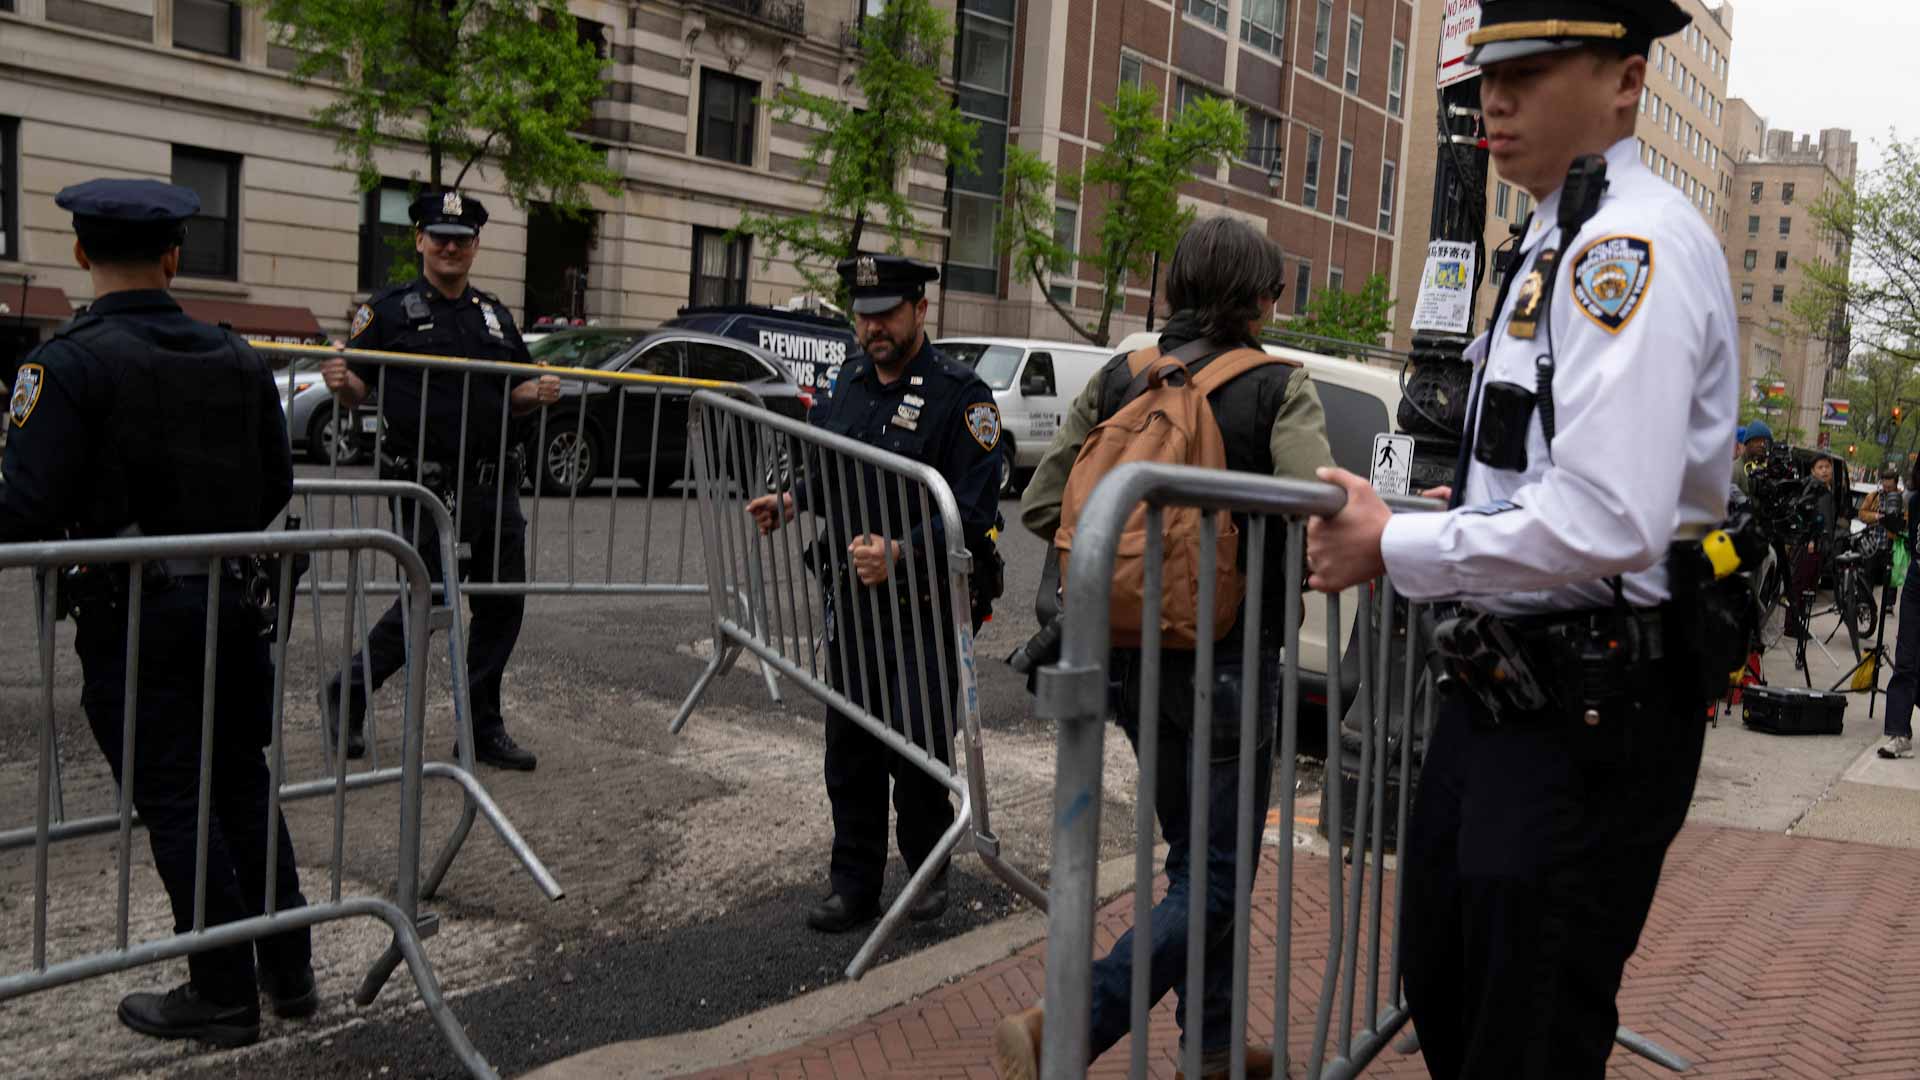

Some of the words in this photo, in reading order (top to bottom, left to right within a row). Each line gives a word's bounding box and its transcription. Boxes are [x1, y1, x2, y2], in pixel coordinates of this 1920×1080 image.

[1448, 2, 1457, 16] NO
[1446, 17, 1475, 40] Anytime
[1588, 239, 1629, 257] POLICE
[759, 330, 846, 365] EYEWITNESS
